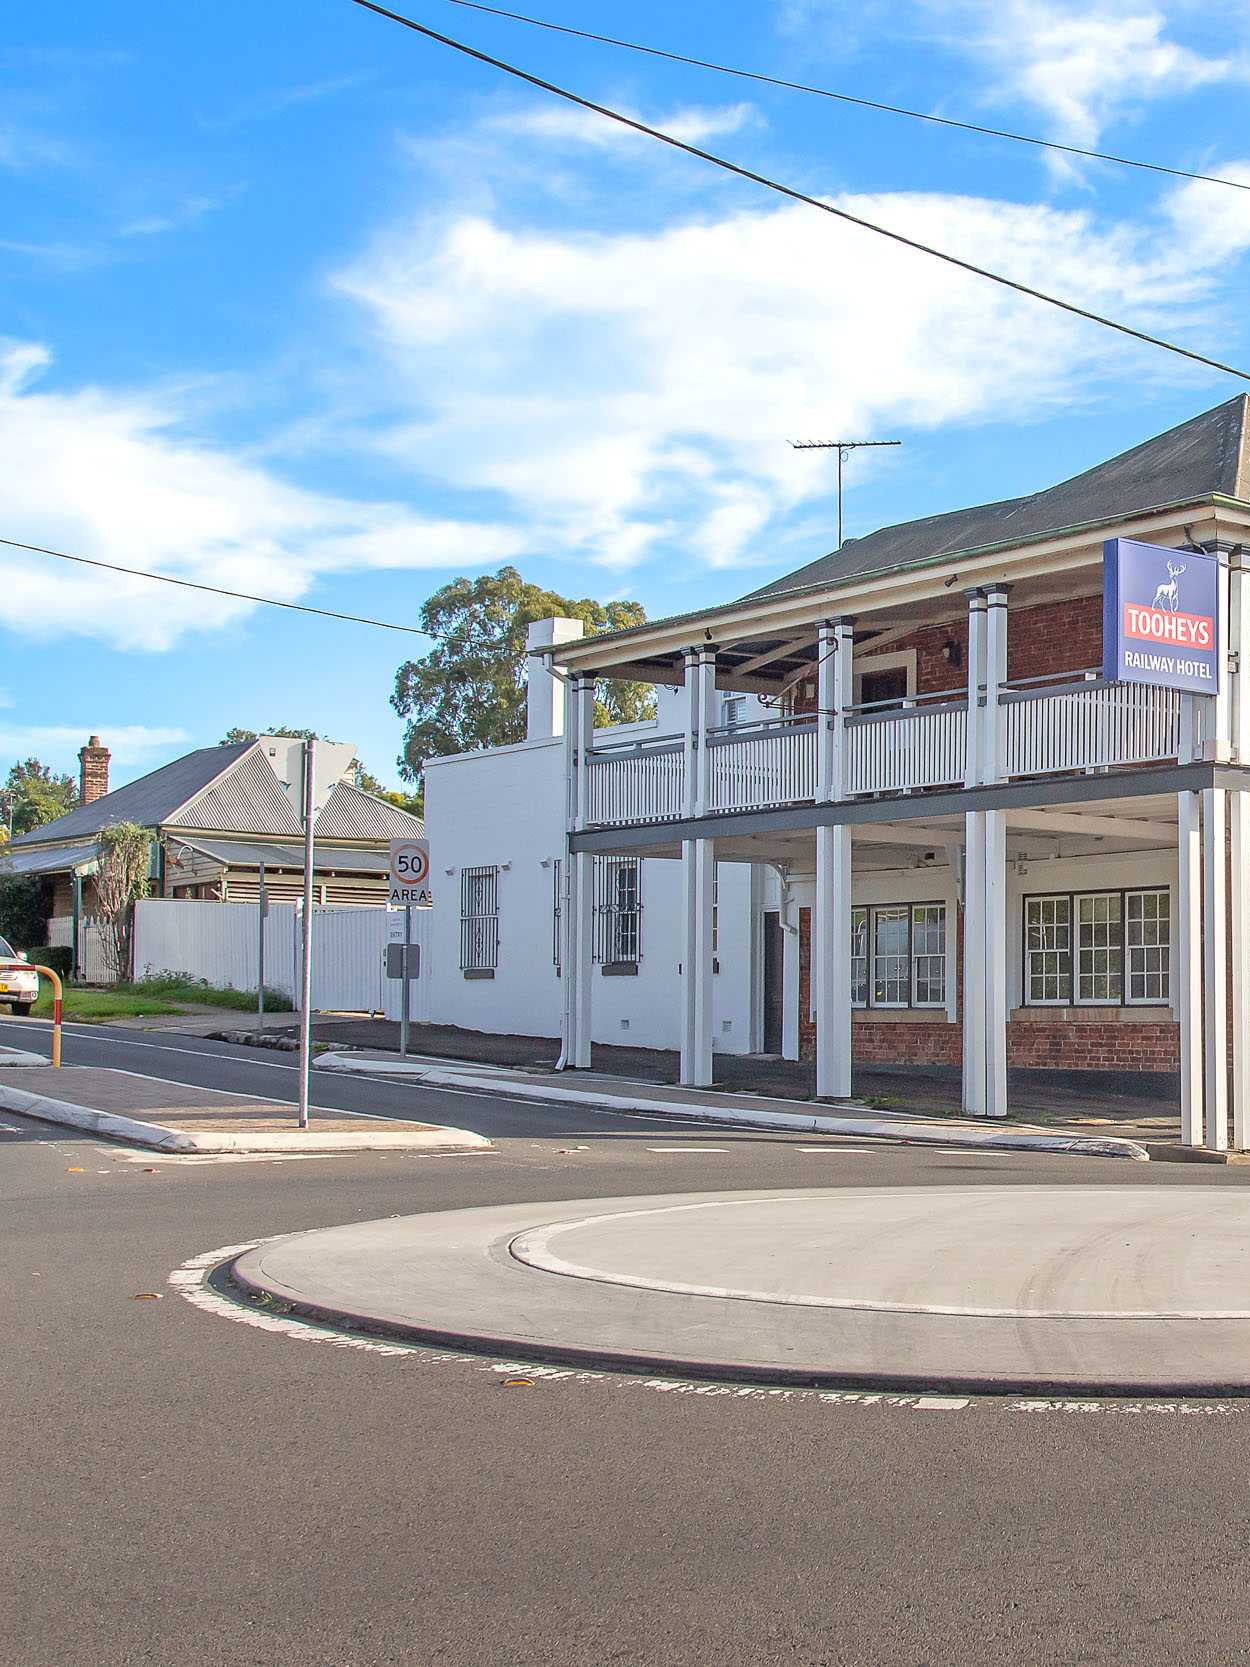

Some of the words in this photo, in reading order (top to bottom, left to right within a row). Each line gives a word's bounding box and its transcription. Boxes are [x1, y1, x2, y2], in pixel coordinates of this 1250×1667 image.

[1127, 608, 1209, 645] TOOHEYS
[1124, 651, 1175, 673] RAILWAY
[1176, 660, 1213, 679] HOTEL
[398, 855, 422, 873] 50
[391, 889, 428, 901] AREA
